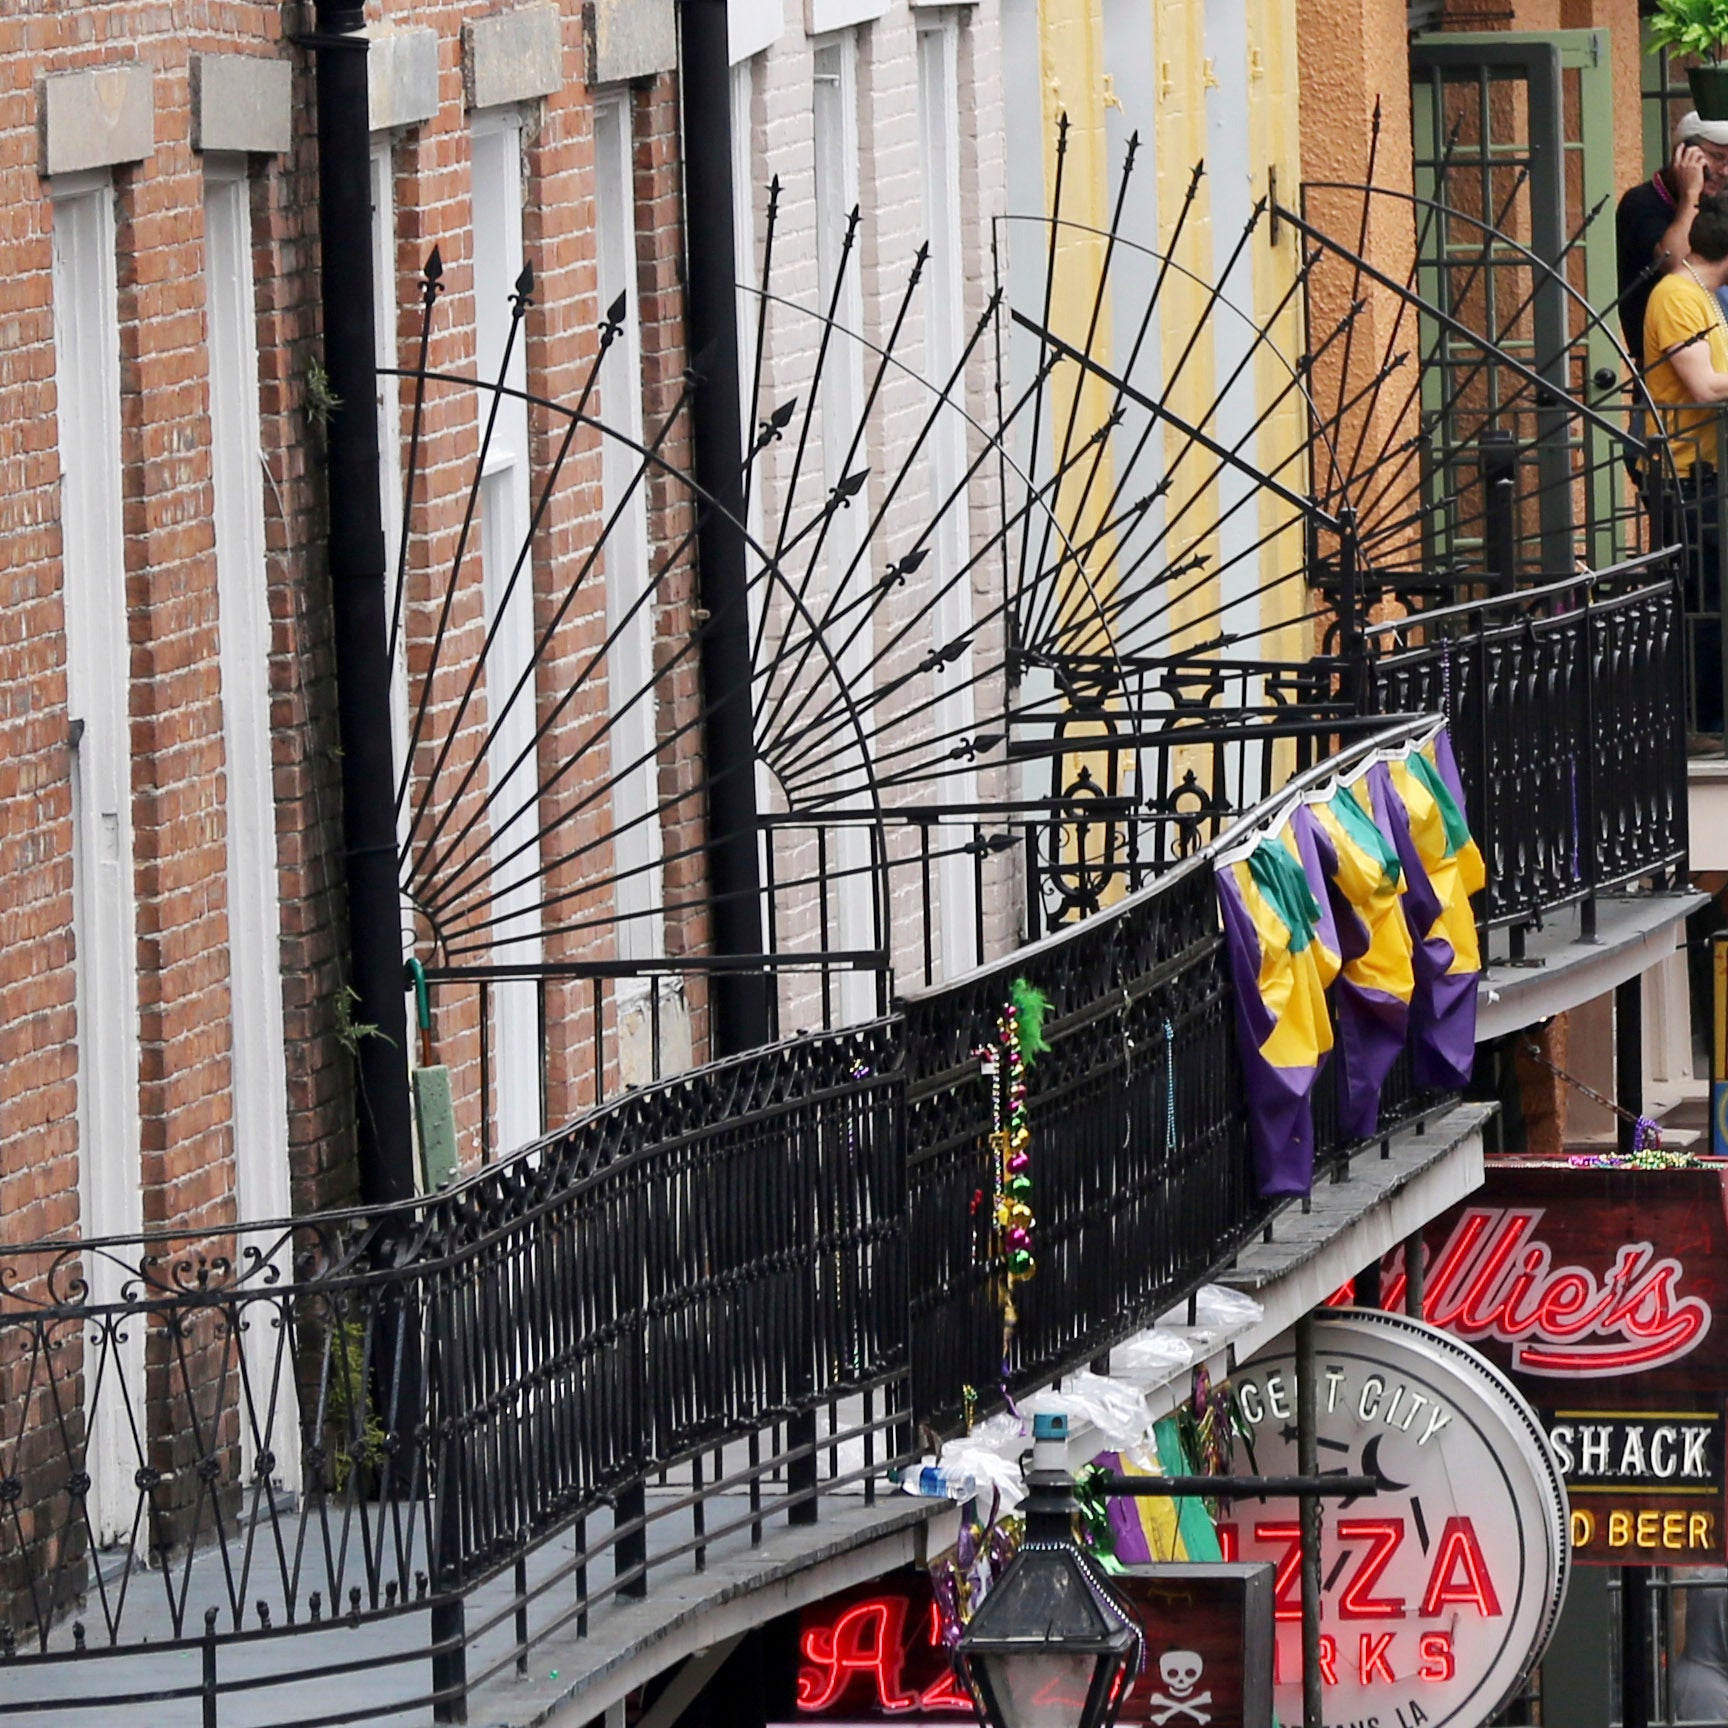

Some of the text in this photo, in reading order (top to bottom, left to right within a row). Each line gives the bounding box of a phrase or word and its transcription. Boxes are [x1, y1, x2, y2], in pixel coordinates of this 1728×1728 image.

[1356, 1376, 1455, 1448] CITY
[1549, 1424, 1713, 1479] SHACK
[1607, 1509, 1716, 1551] BEER
[1216, 1515, 1503, 1620] ZZA
